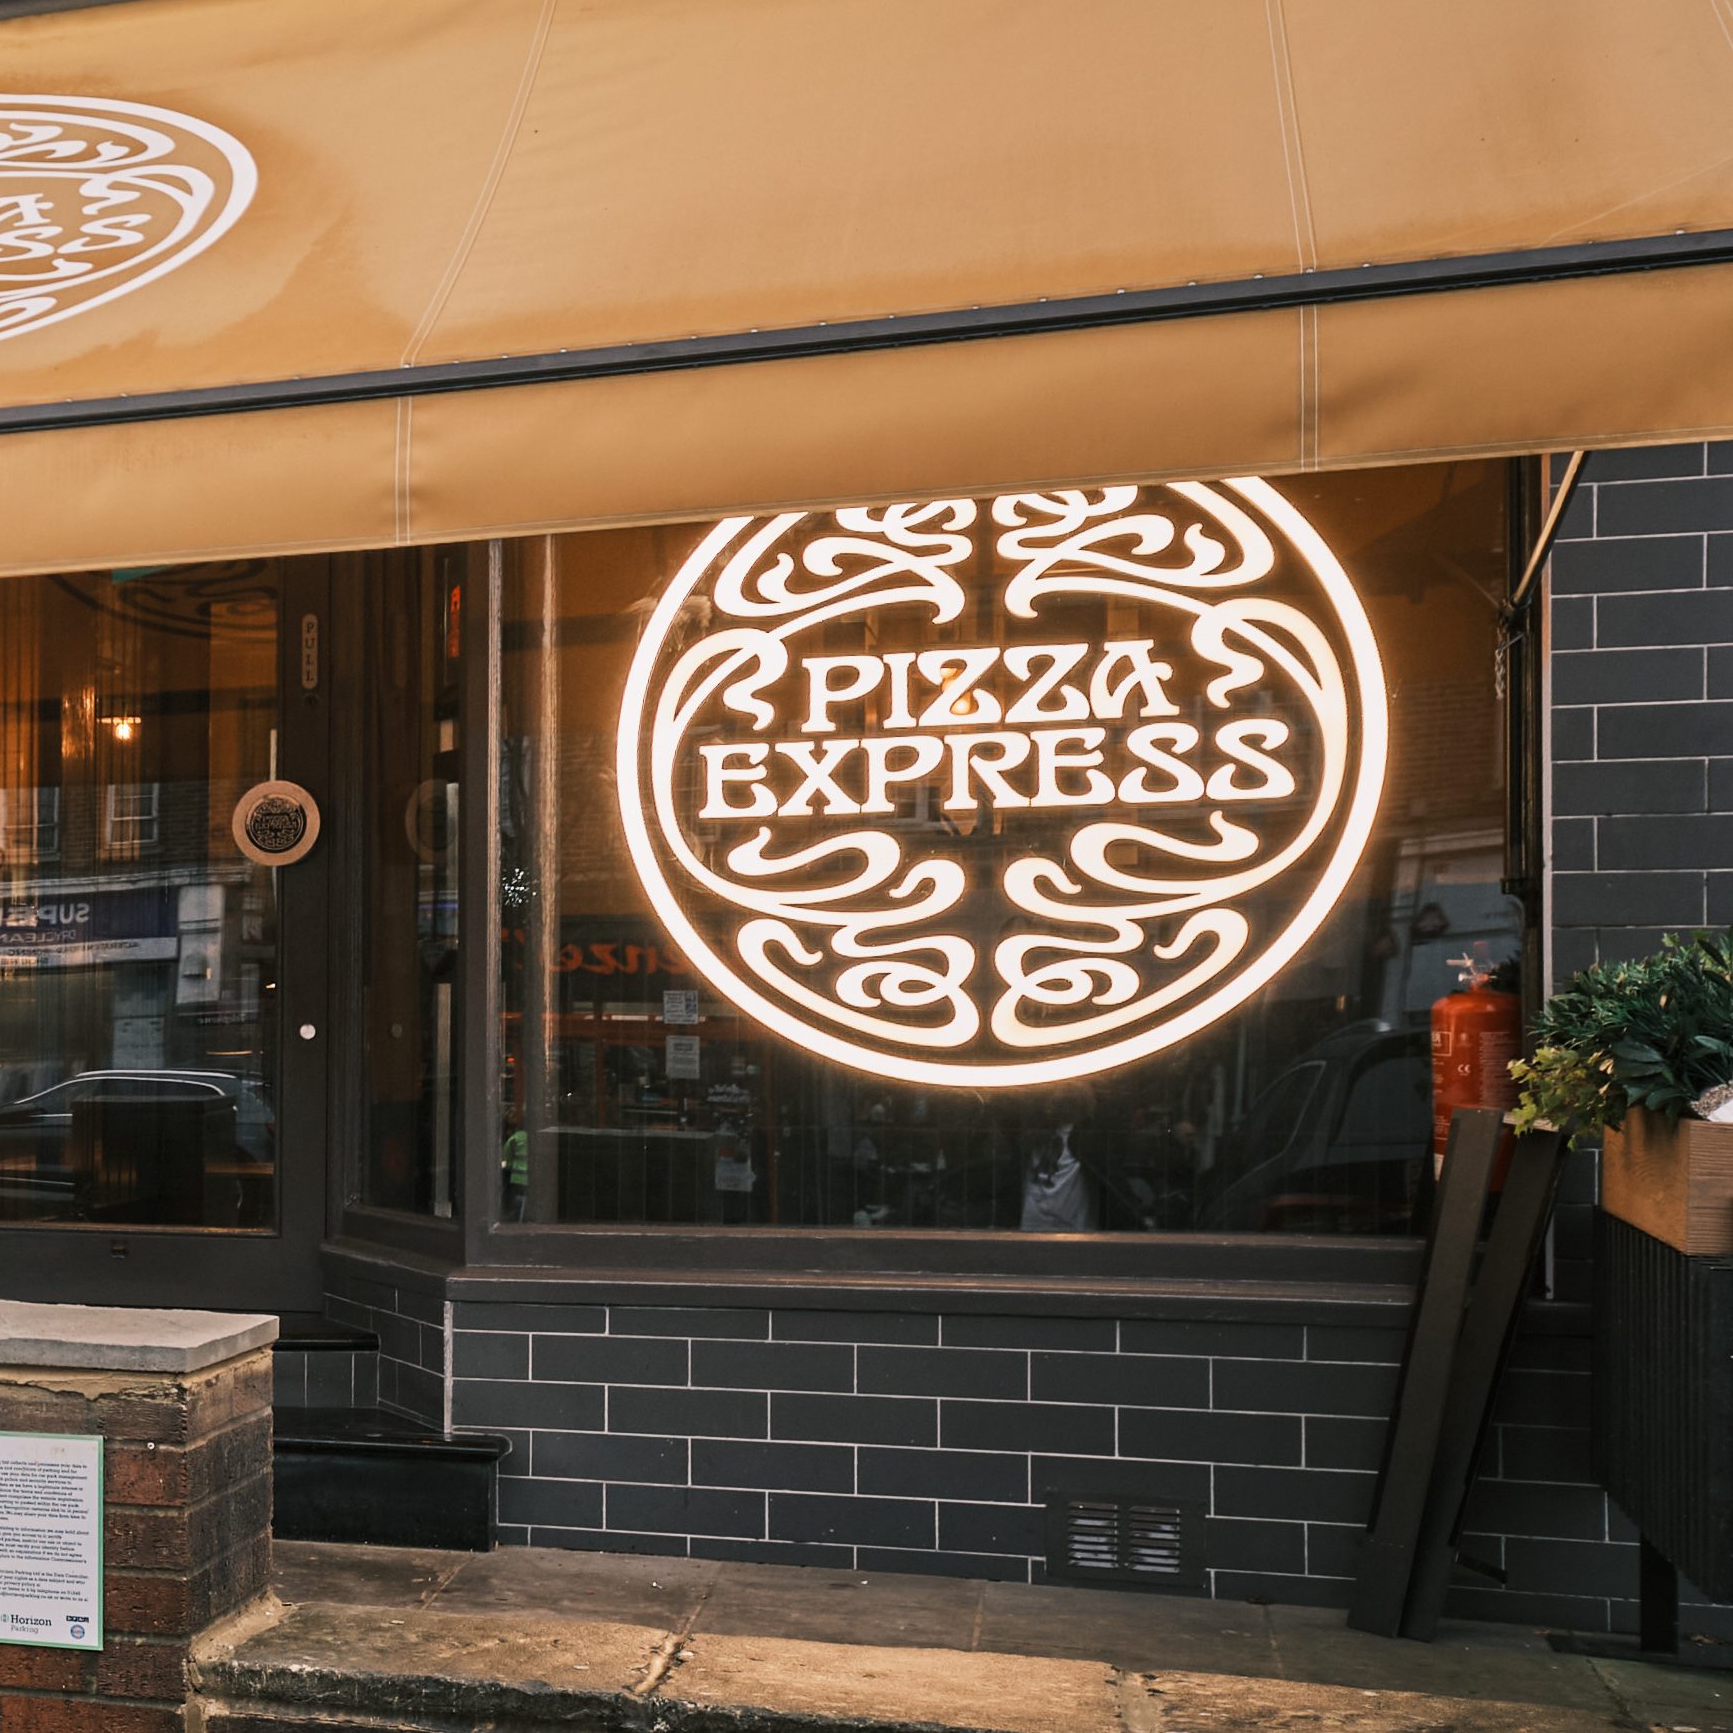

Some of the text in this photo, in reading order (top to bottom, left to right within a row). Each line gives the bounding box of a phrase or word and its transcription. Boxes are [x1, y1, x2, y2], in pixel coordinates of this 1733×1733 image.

[305, 621, 315, 682] PULL
[801, 639, 1181, 733] PIZZA
[699, 718, 1297, 819] EXPRESS
[11, 1615, 52, 1626] Horizon
